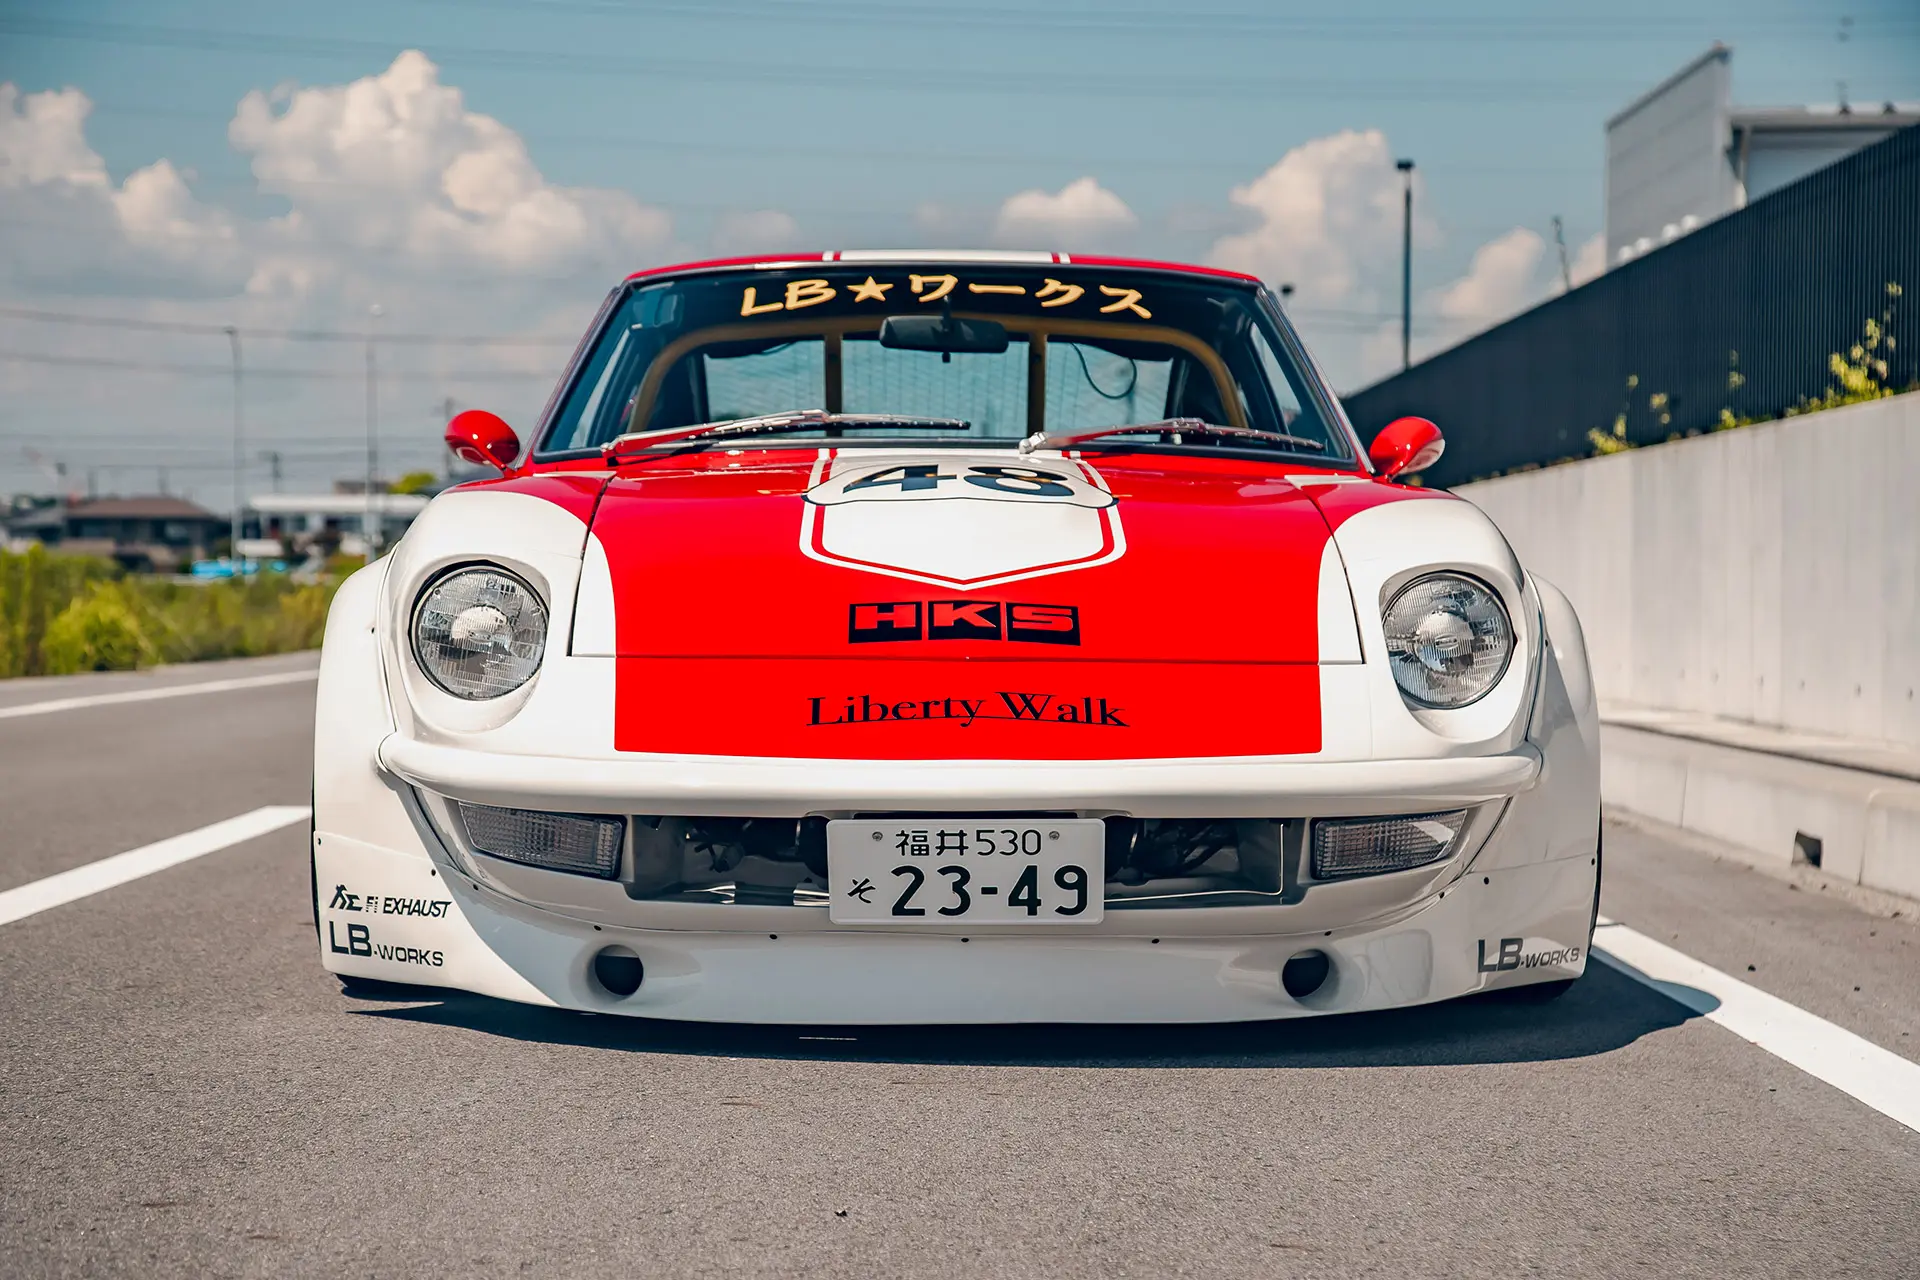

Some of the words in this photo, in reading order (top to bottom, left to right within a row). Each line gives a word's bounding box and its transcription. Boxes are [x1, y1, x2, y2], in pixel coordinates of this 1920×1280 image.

[740, 278, 837, 316] LB
[853, 602, 1074, 632] HKS
[806, 694, 985, 728] Liberty
[995, 691, 1130, 727] Walk
[383, 897, 452, 919] EXHAUST
[847, 878, 876, 904] そ
[890, 864, 1088, 917] 23-49
